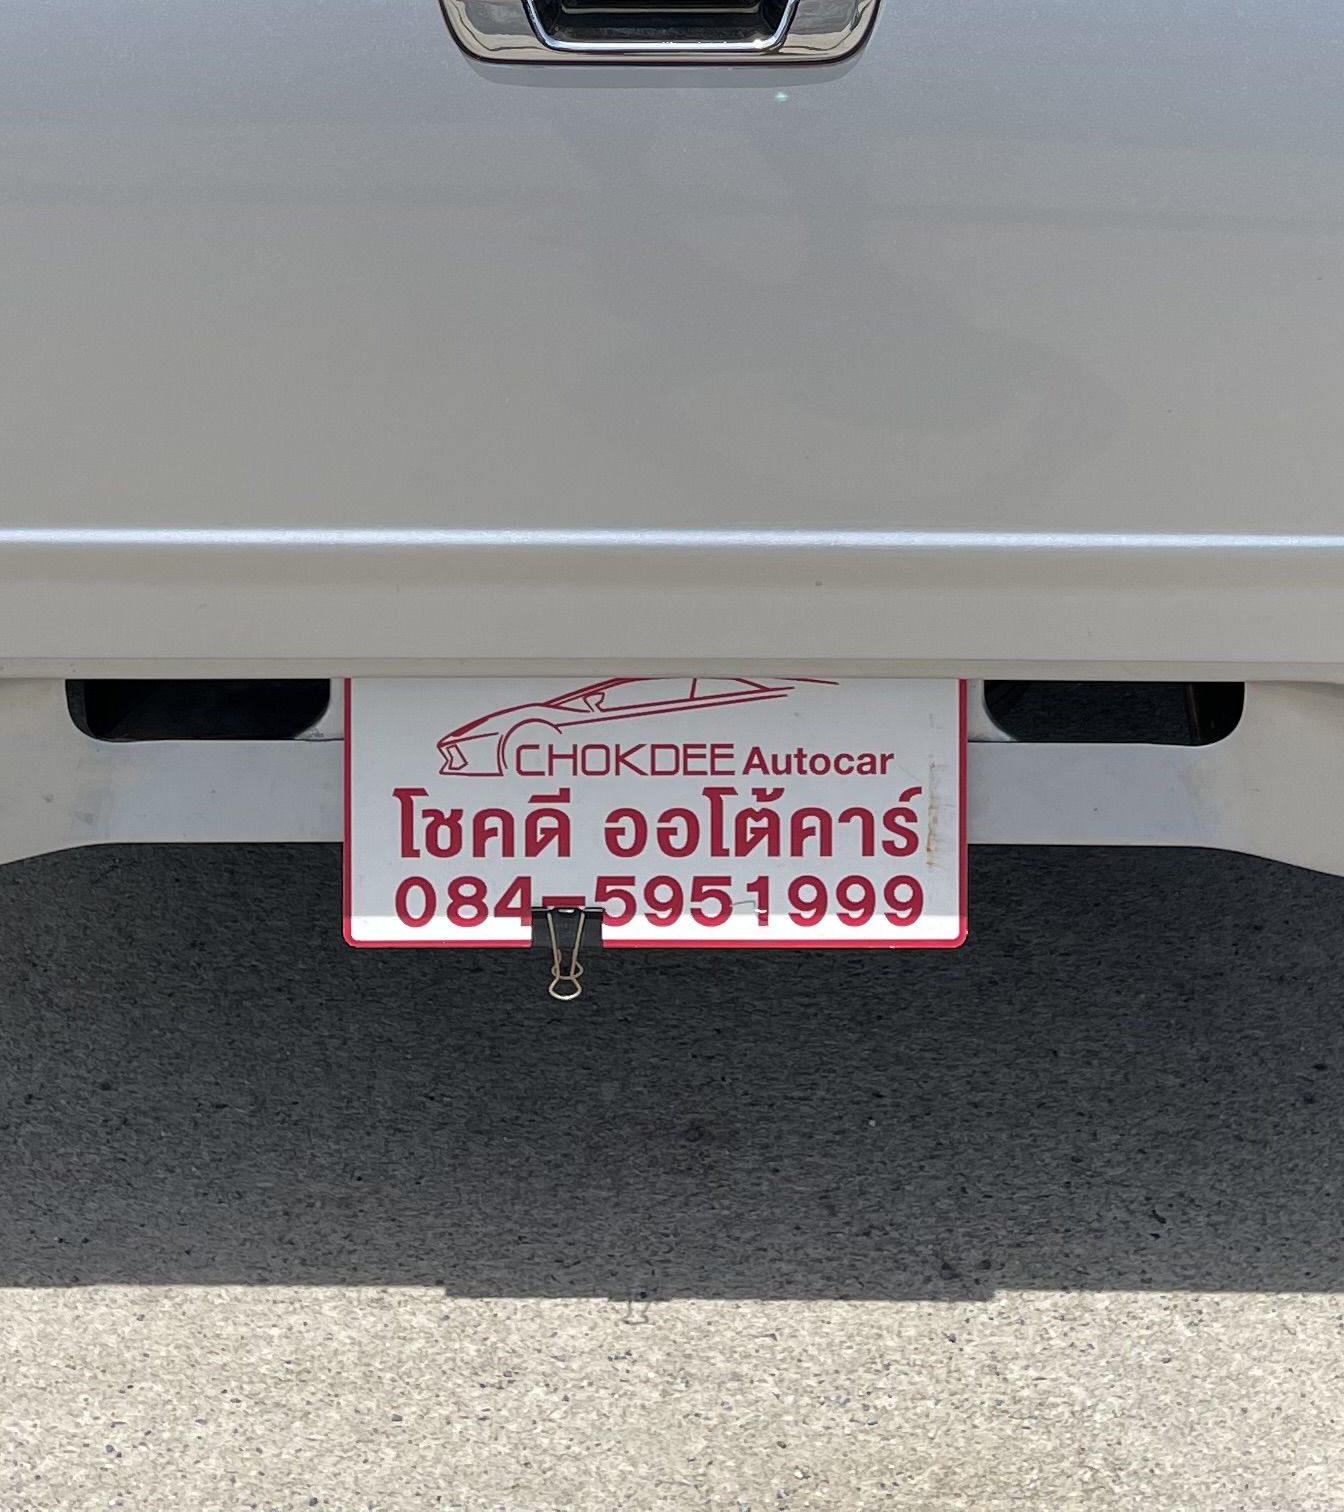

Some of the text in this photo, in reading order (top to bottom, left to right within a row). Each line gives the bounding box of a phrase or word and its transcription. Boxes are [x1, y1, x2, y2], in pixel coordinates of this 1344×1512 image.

[515, 743, 895, 777] CHOKDEE Autocar
[393, 785, 923, 859] โชคดี ออโต้คาร์
[394, 874, 925, 928] 084-5951999
